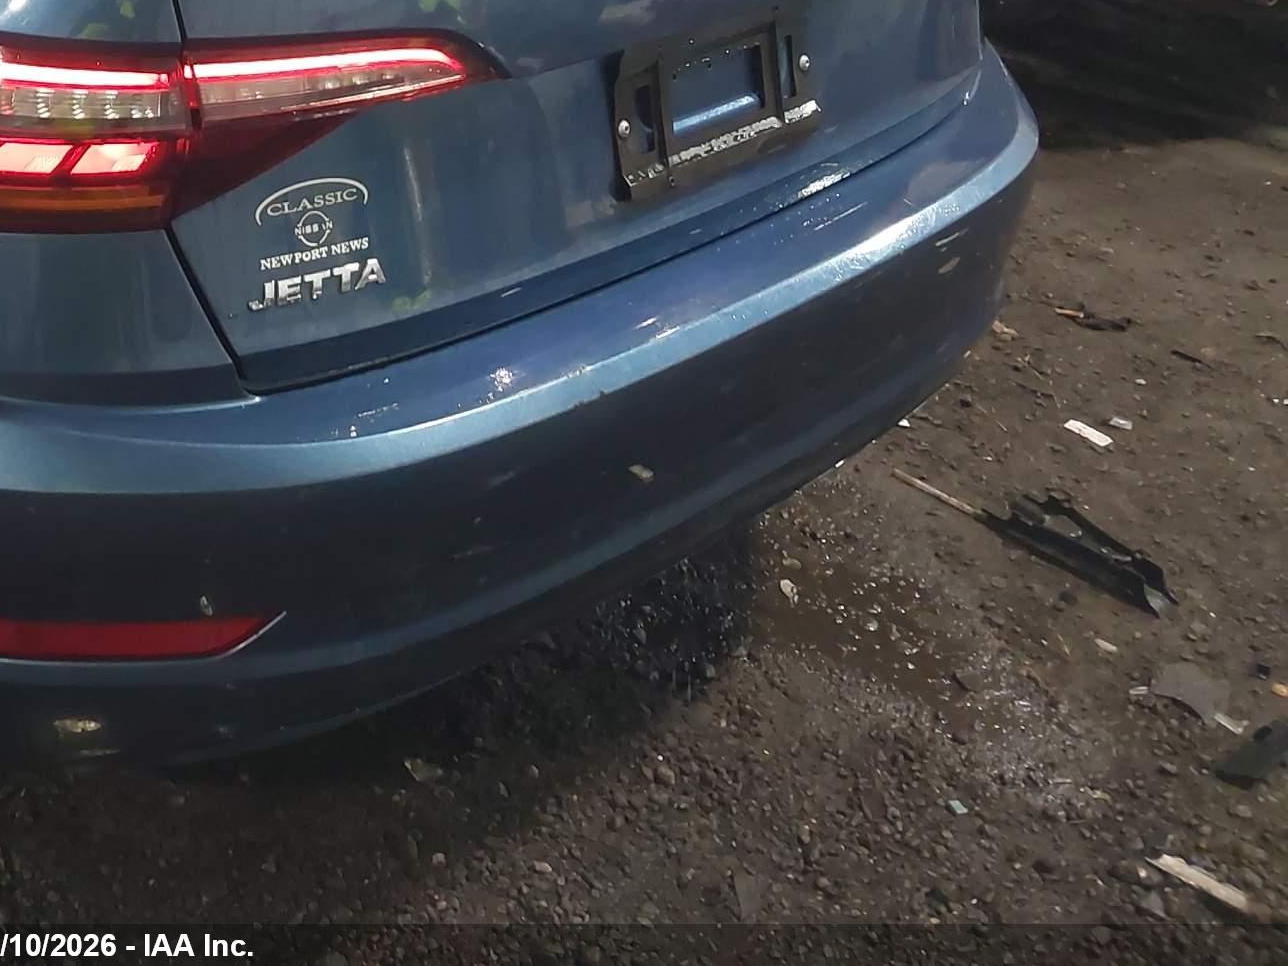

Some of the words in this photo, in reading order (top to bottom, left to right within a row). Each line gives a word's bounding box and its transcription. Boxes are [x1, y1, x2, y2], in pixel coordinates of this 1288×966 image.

[267, 188, 358, 215] CLASSIC
[331, 237, 369, 255] NEWS
[247, 258, 387, 311] JETTA
